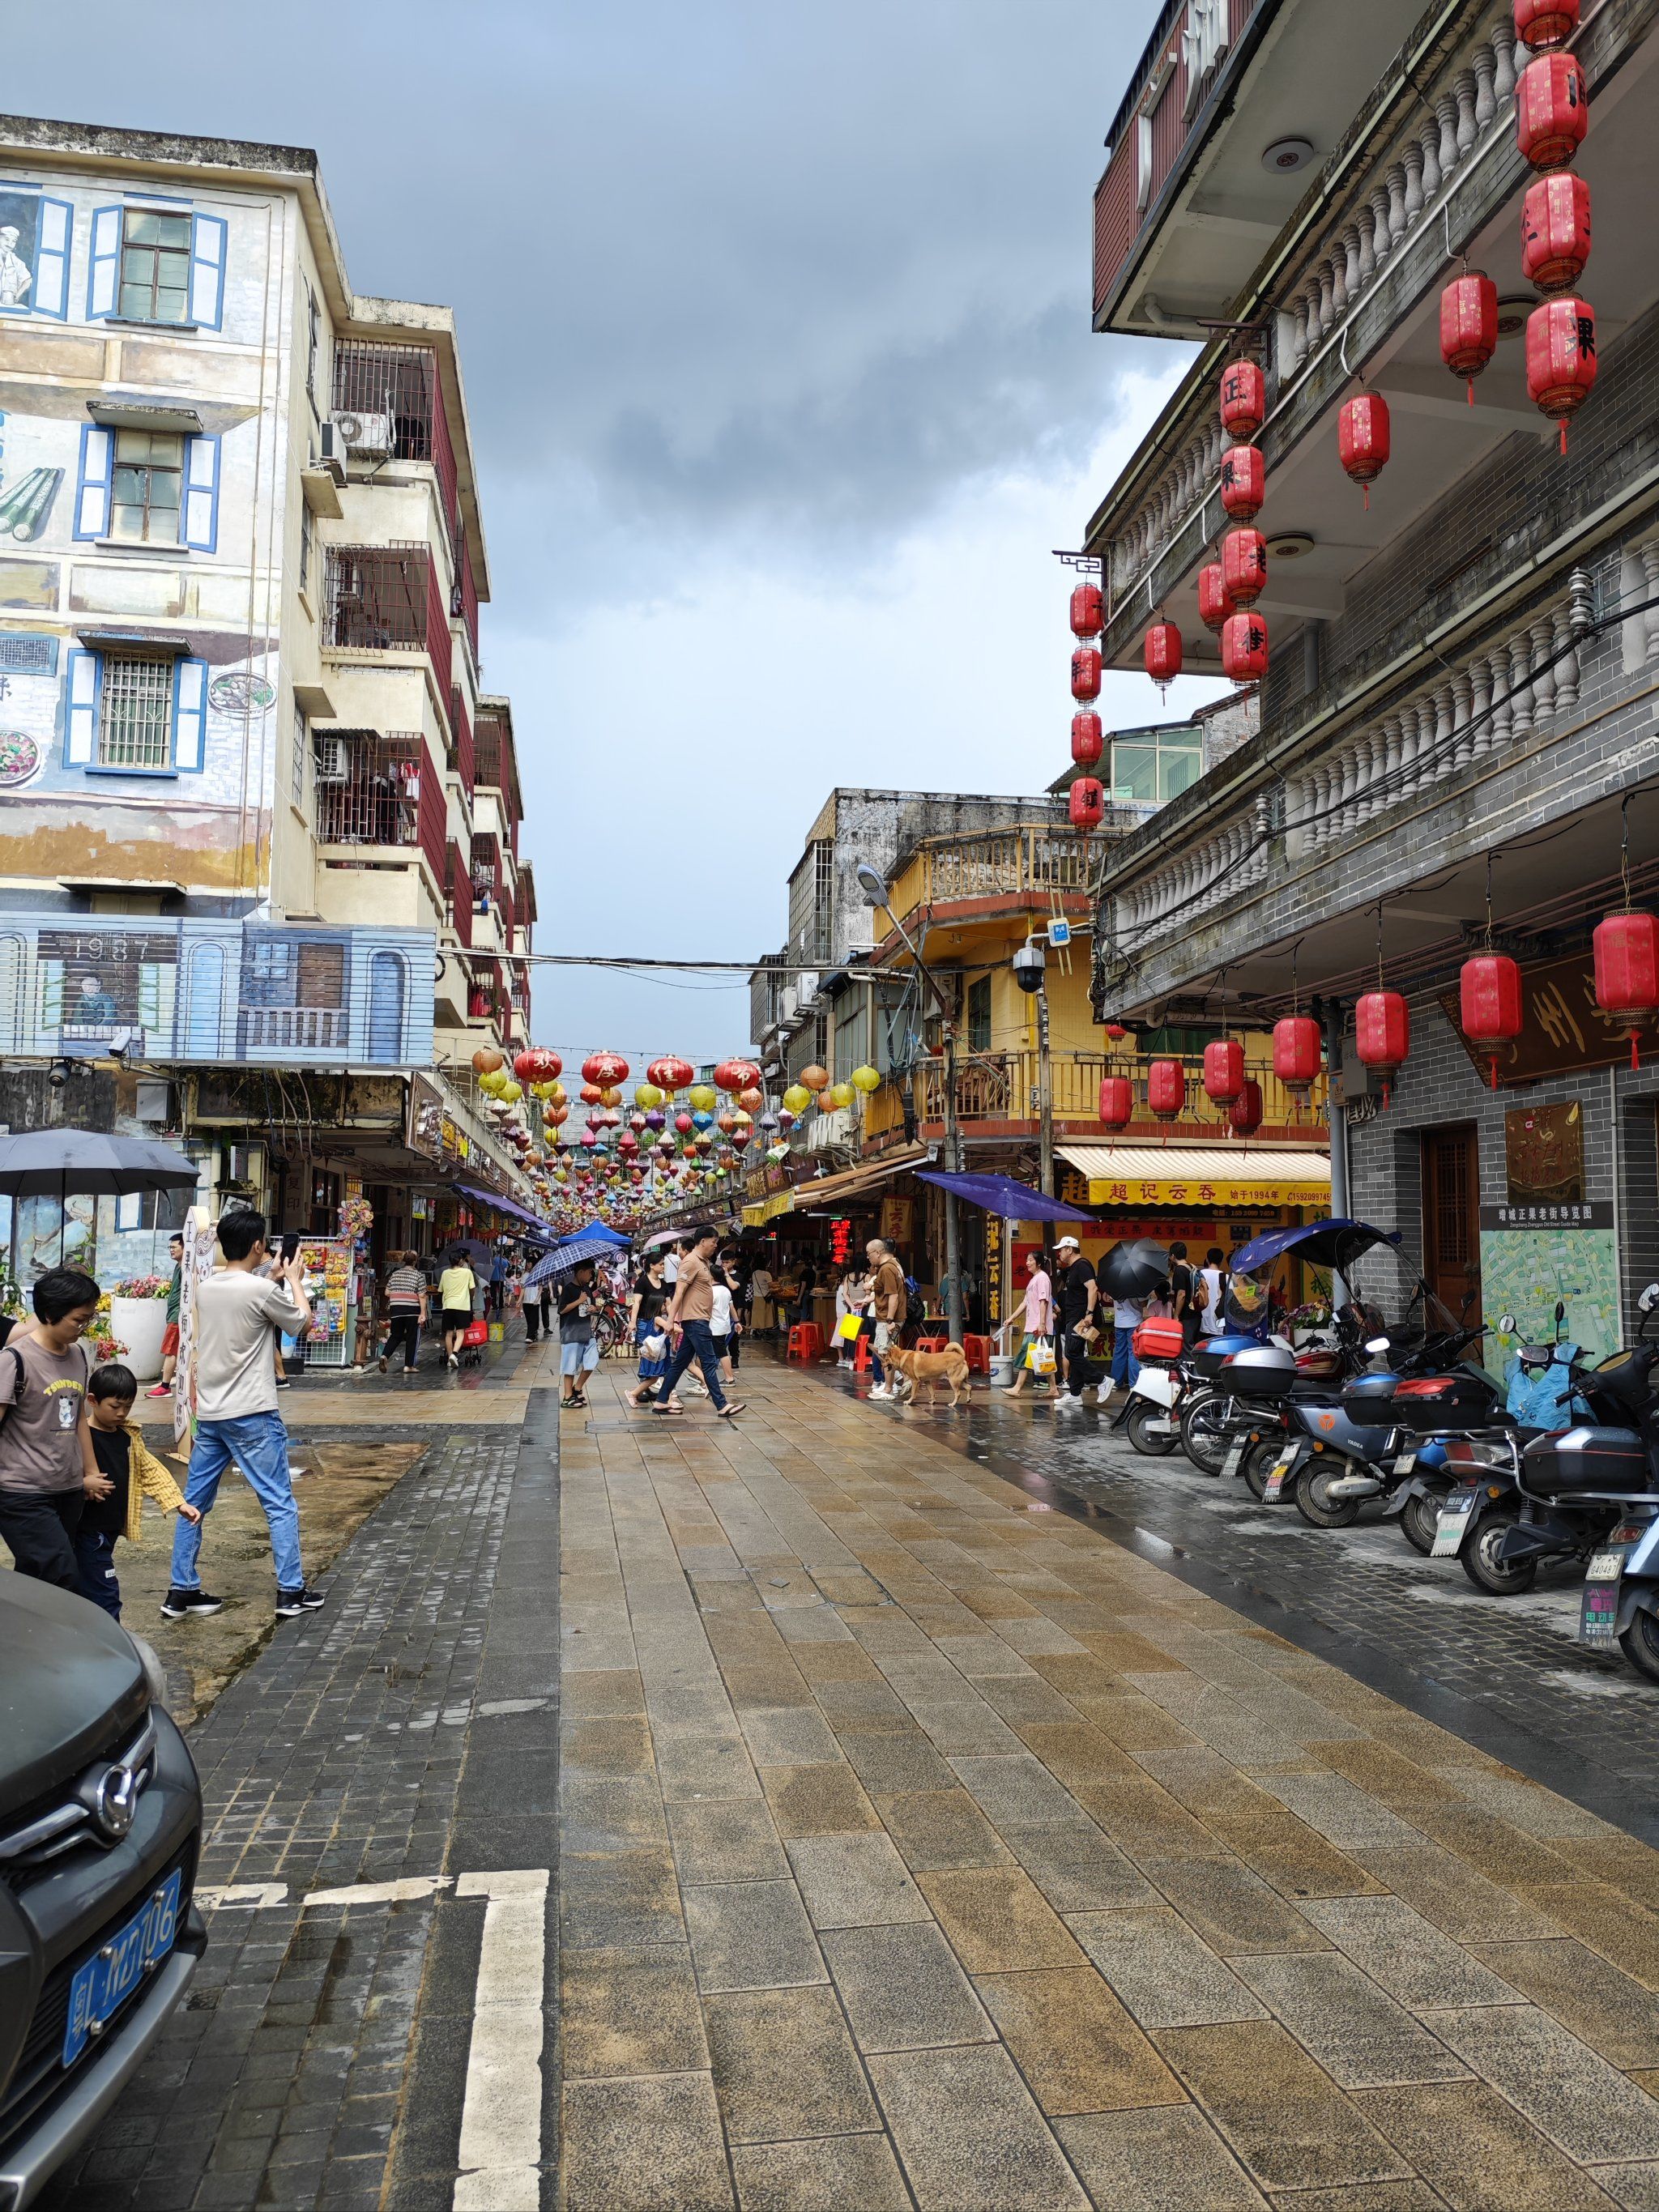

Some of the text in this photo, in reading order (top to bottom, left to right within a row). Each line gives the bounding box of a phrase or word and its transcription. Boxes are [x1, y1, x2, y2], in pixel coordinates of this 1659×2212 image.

[76, 938, 149, 962] 1987
[1108, 1183, 1217, 1201] 超记云吞
[1230, 1189, 1280, 1200] 始于1994年
[1499, 1205, 1593, 1221] 增城正果老街导览图
